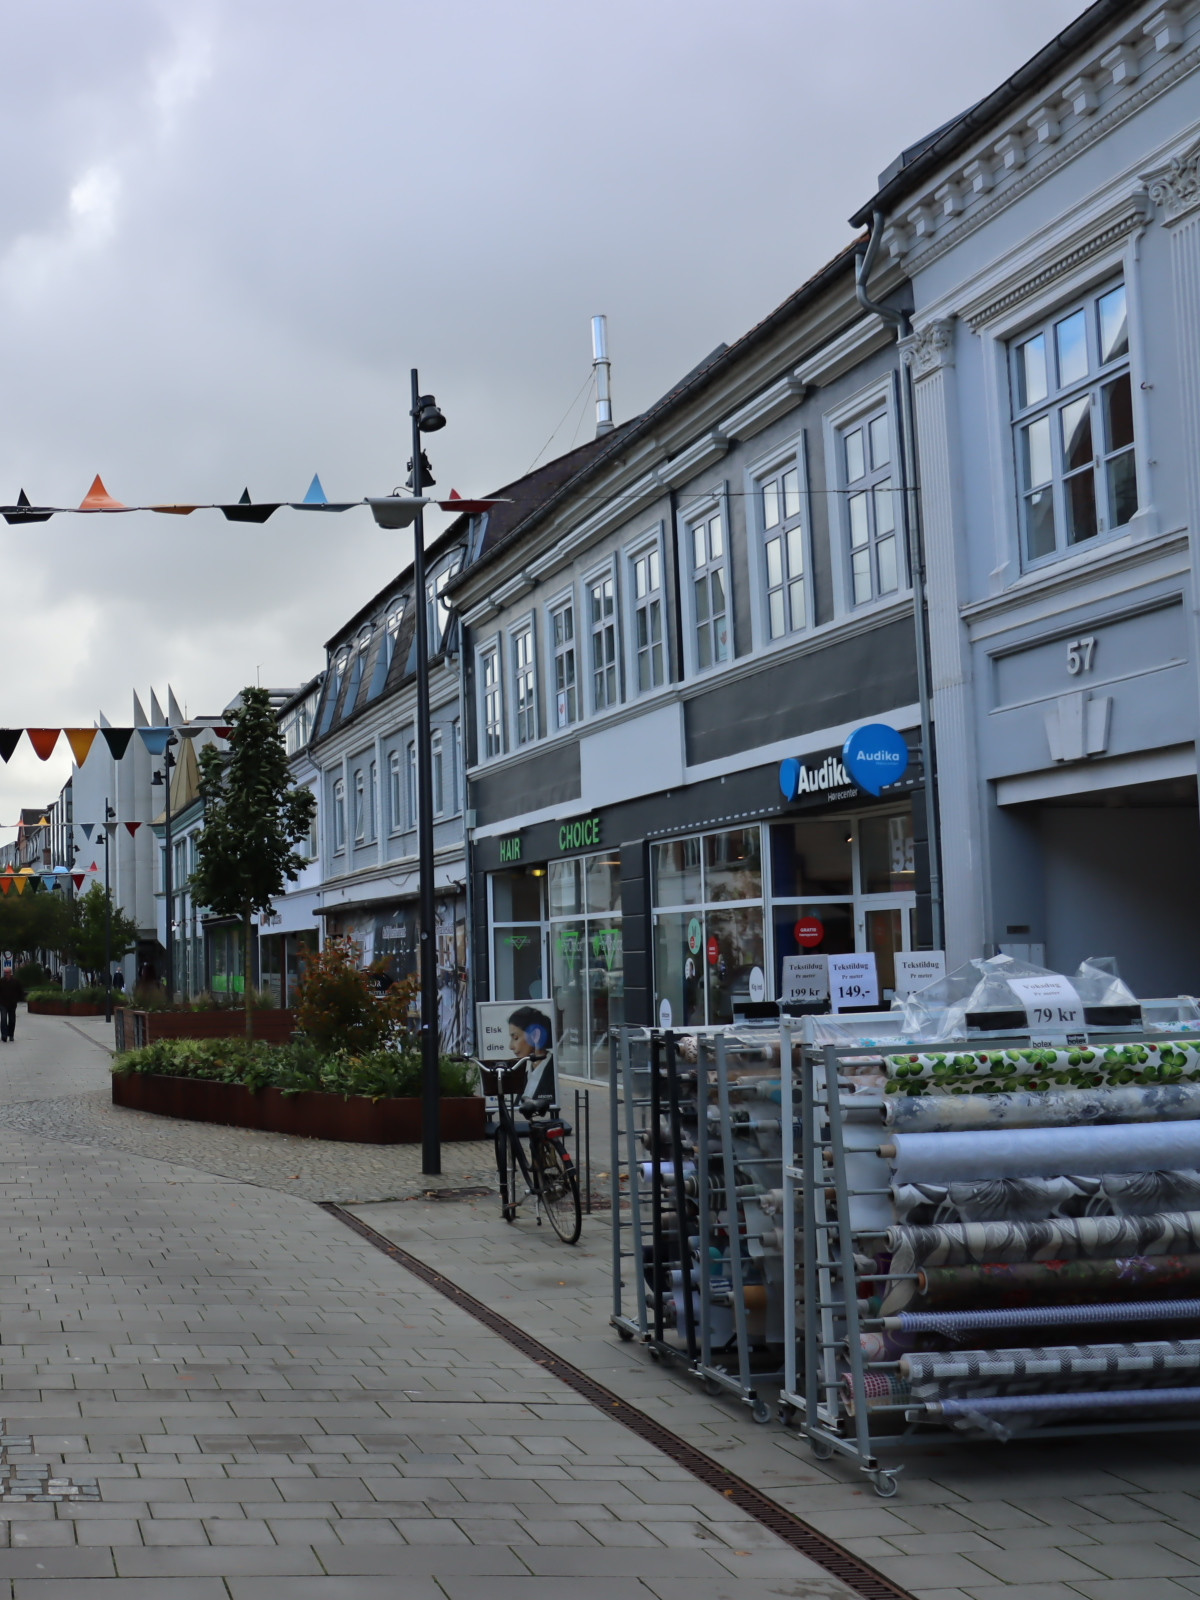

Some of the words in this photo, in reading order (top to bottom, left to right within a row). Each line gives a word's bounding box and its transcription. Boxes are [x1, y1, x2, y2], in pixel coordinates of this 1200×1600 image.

[1067, 636, 1094, 674] 57
[856, 750, 900, 761] Audika
[500, 837, 521, 862] HAIR
[559, 818, 600, 851] CHOICE
[789, 963, 823, 971] Tekstildug
[833, 962, 869, 971] Tekstildug
[902, 961, 939, 969] Tekstildug
[790, 988, 806, 997] 199
[809, 988, 820, 996] kr
[838, 985, 870, 998] 149,-
[1033, 1008, 1052, 1023] 79
[1058, 1008, 1076, 1022] kr
[486, 1043, 504, 1051] dine
